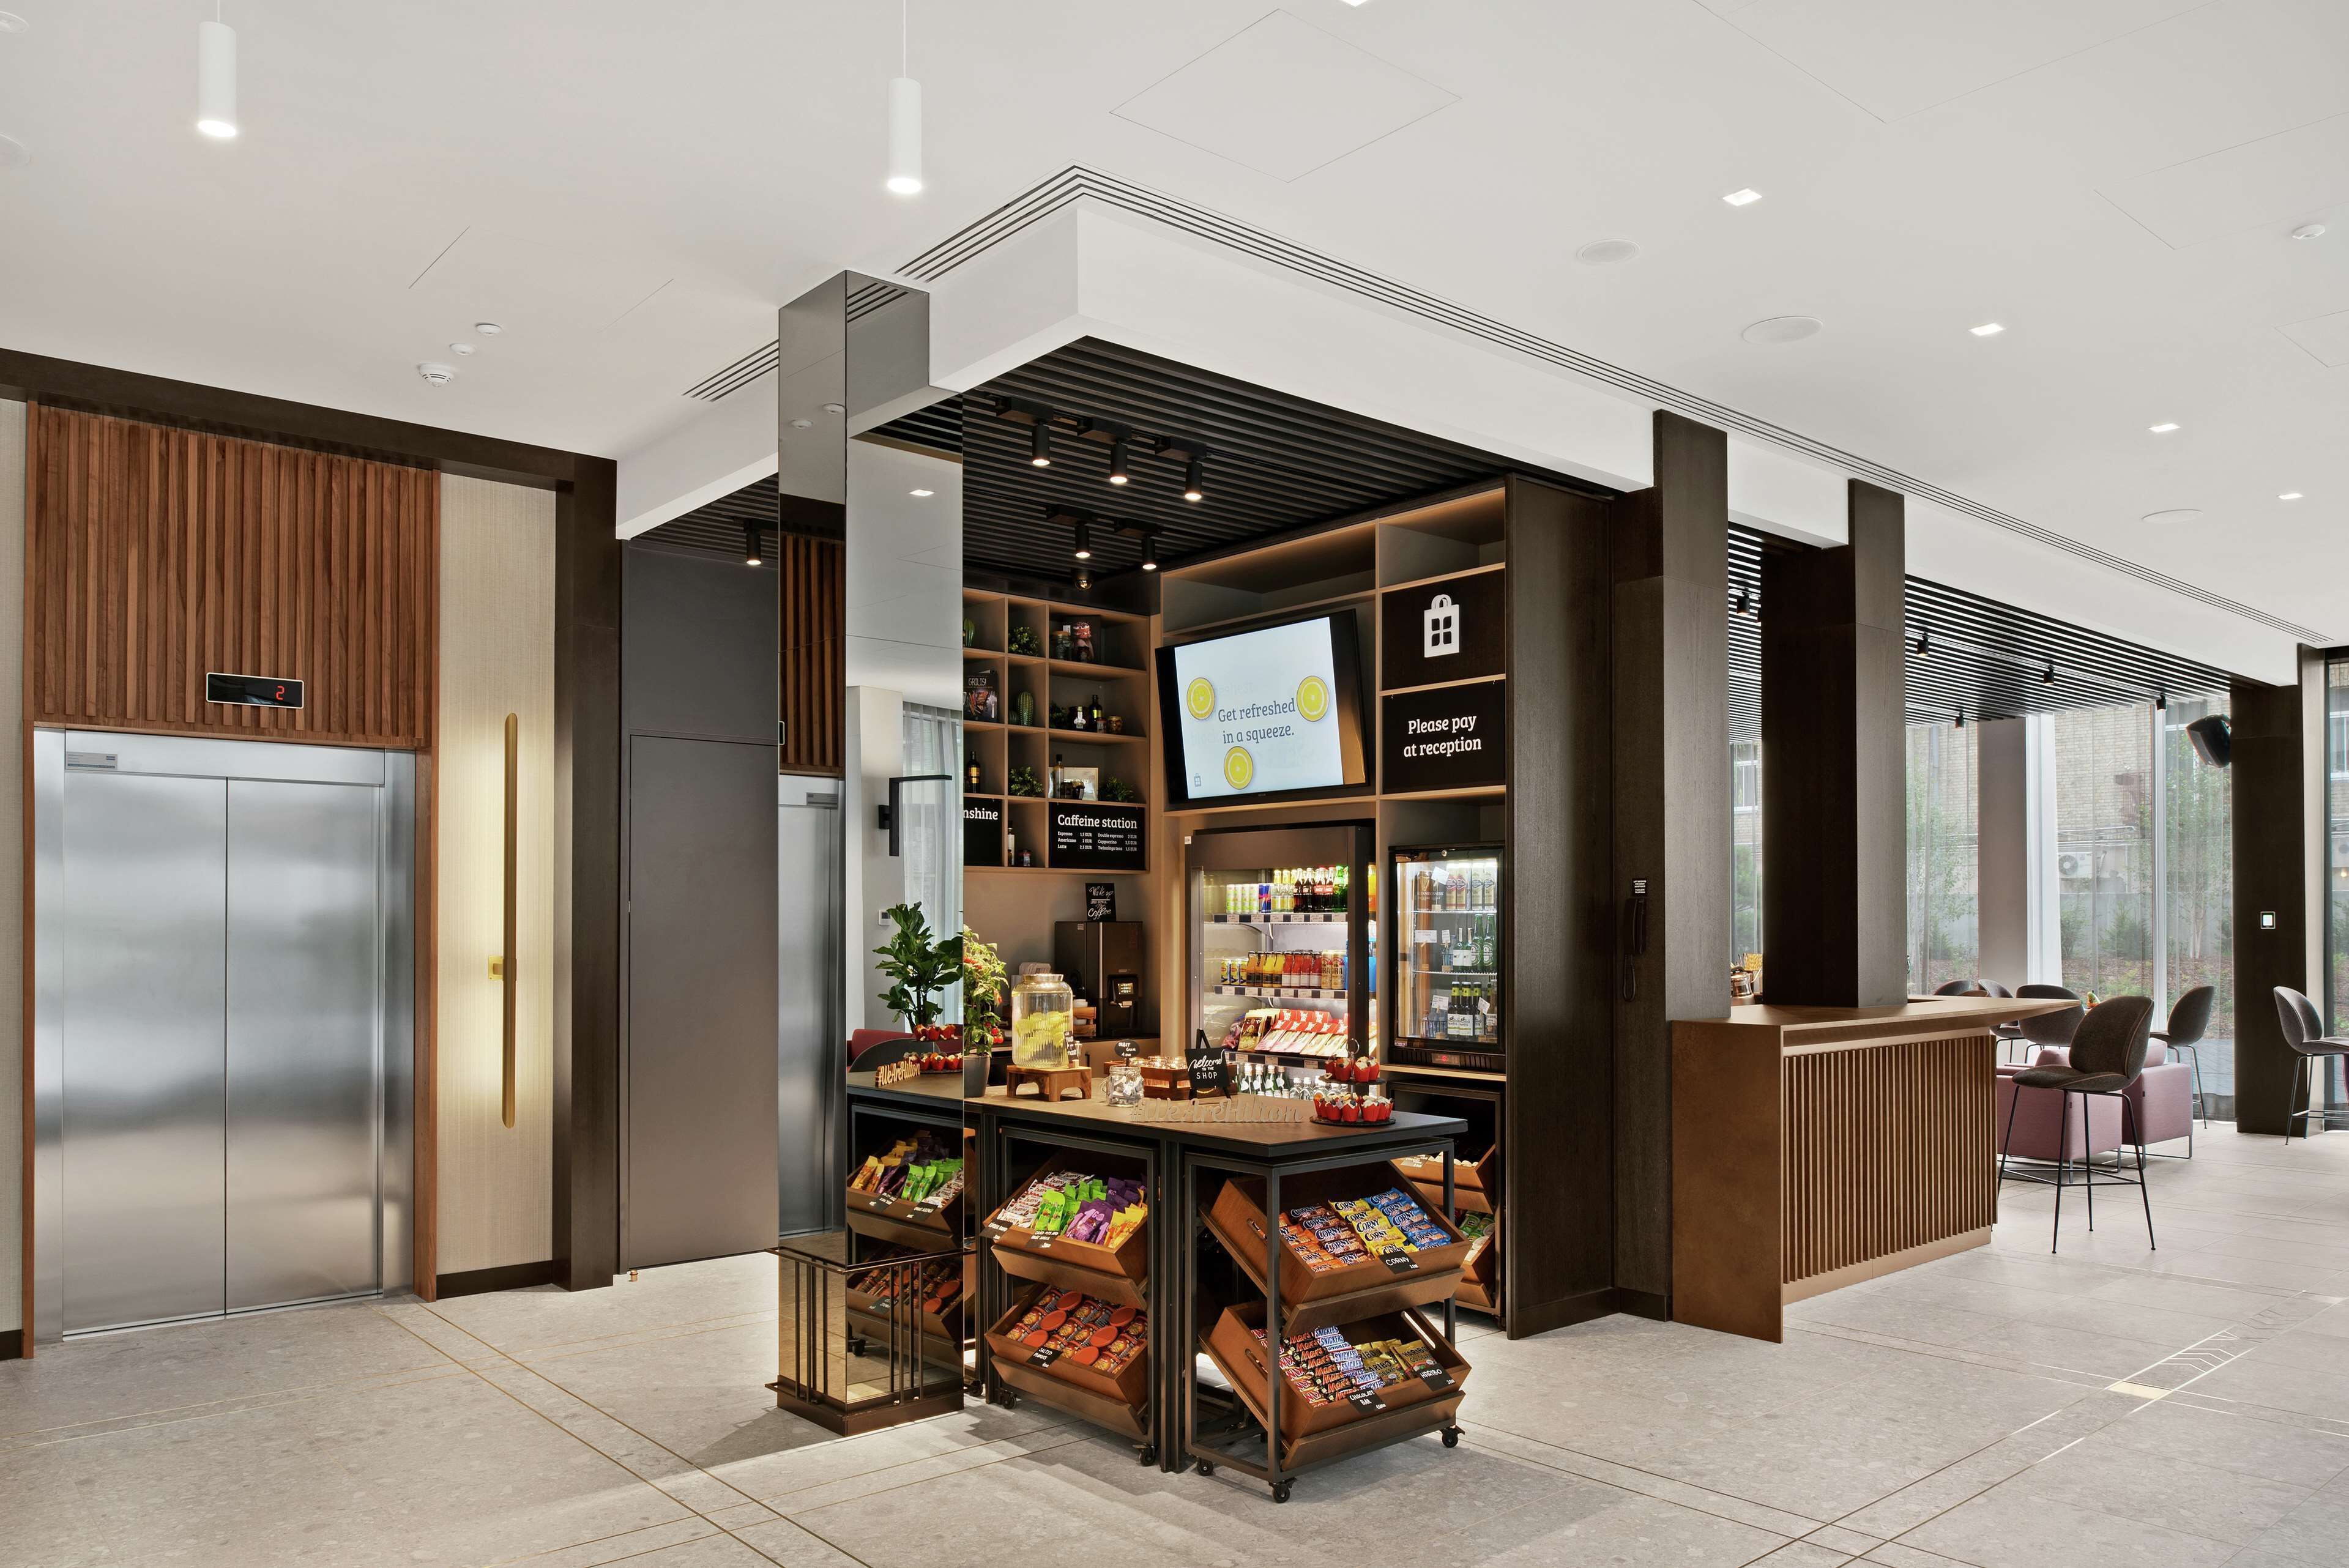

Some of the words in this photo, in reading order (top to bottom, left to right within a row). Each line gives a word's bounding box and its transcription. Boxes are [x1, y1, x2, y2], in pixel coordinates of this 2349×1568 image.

[276, 685, 285, 700] 2
[1218, 708, 1237, 722] Get
[1240, 698, 1295, 719] refreshed
[1408, 719, 1449, 734] Please
[1452, 716, 1476, 733] pay
[1223, 730, 1234, 743] in
[1237, 732, 1243, 742] a
[1246, 725, 1295, 743] squeeze.
[1404, 744, 1417, 757] at
[1420, 737, 1481, 757] reception
[1058, 814, 1100, 827] Caffeine
[1102, 817, 1137, 828] station
[1291, 1206, 1316, 1217] CORNY
[1335, 1200, 1356, 1211] CORNY
[1382, 1202, 1403, 1216] CORNY
[1303, 1216, 1329, 1229] CORNY
[1344, 1210, 1368, 1223] CORNY
[1392, 1210, 1414, 1225] CORNY
[1357, 1219, 1380, 1233] CORNY
[1315, 1227, 1342, 1241] CORNY
[1365, 1230, 1388, 1241] CORNY
[1325, 1239, 1350, 1254] CORNY
[1385, 1257, 1410, 1266] CORNY
[1316, 1326, 1339, 1337] SNICKERS
[1321, 1335, 1344, 1346] SNICKERS
[1420, 1369, 1442, 1379] HARIBO
[1349, 1390, 1375, 1400] CHOCOLATE
